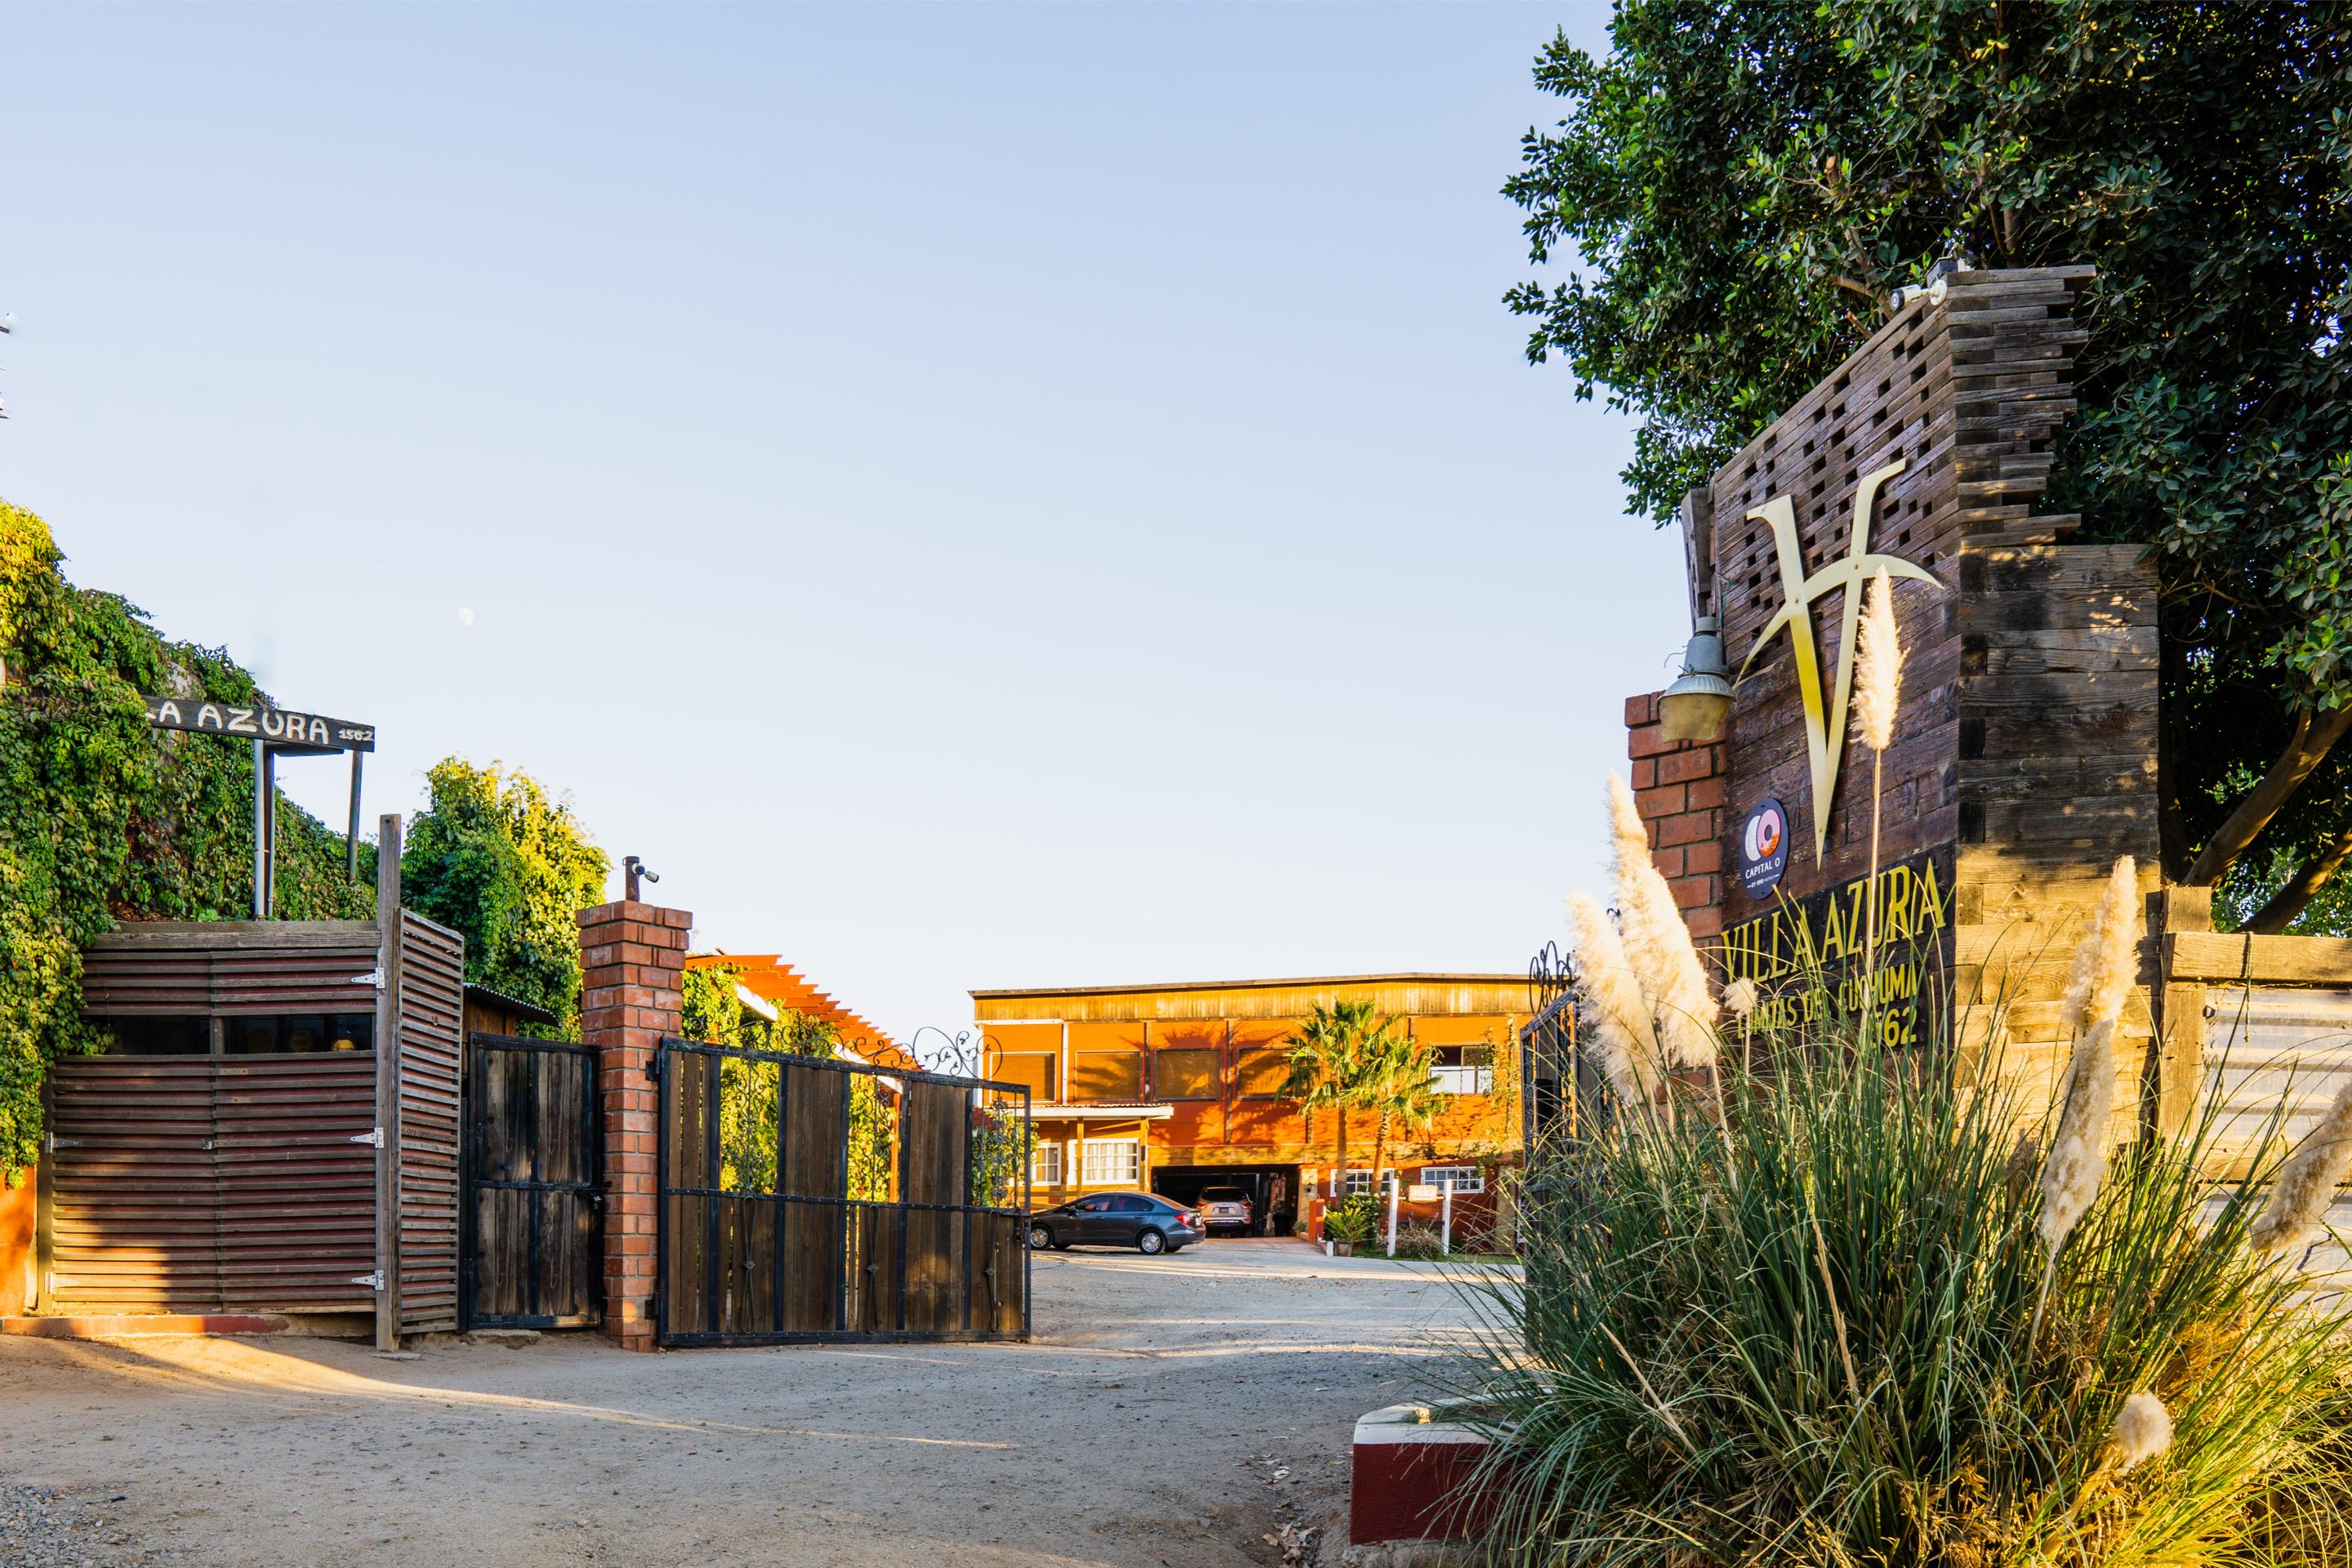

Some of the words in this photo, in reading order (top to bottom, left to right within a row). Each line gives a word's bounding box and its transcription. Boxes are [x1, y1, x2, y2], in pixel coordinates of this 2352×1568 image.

[145, 701, 181, 724] A
[197, 703, 330, 745] AZURA
[1745, 860, 1773, 880] CAPITAL
[1775, 857, 1780, 867] O
[1721, 904, 1815, 983] VILLA
[1820, 858, 1946, 963] AZURA
[1860, 1006, 1918, 1049] 62
